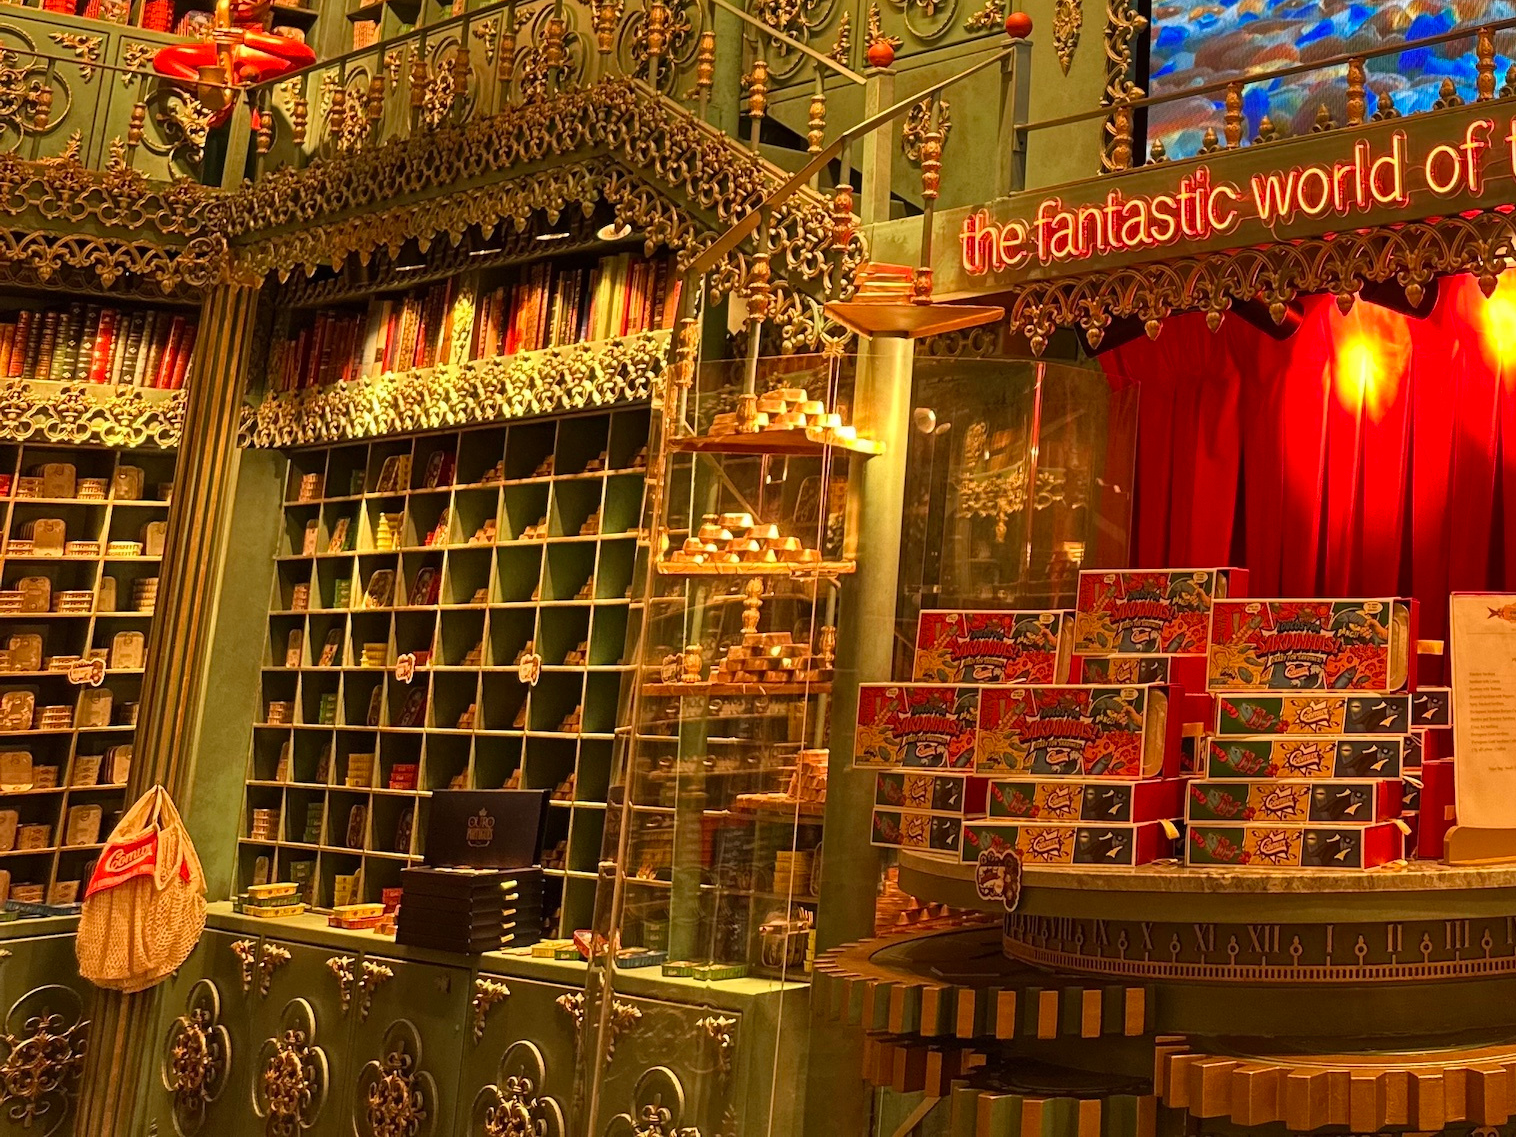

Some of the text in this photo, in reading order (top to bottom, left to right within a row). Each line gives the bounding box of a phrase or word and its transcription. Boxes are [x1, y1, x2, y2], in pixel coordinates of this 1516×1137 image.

[959, 208, 1028, 275] the
[1034, 166, 1244, 263] fantastic
[1253, 130, 1408, 220] world
[1424, 119, 1493, 198] of
[1140, 922, 1155, 951] X
[1194, 924, 1217, 953] XI
[1247, 924, 1281, 954] XII
[1326, 924, 1335, 954] I
[1386, 923, 1403, 953] II
[1445, 919, 1470, 950] III
